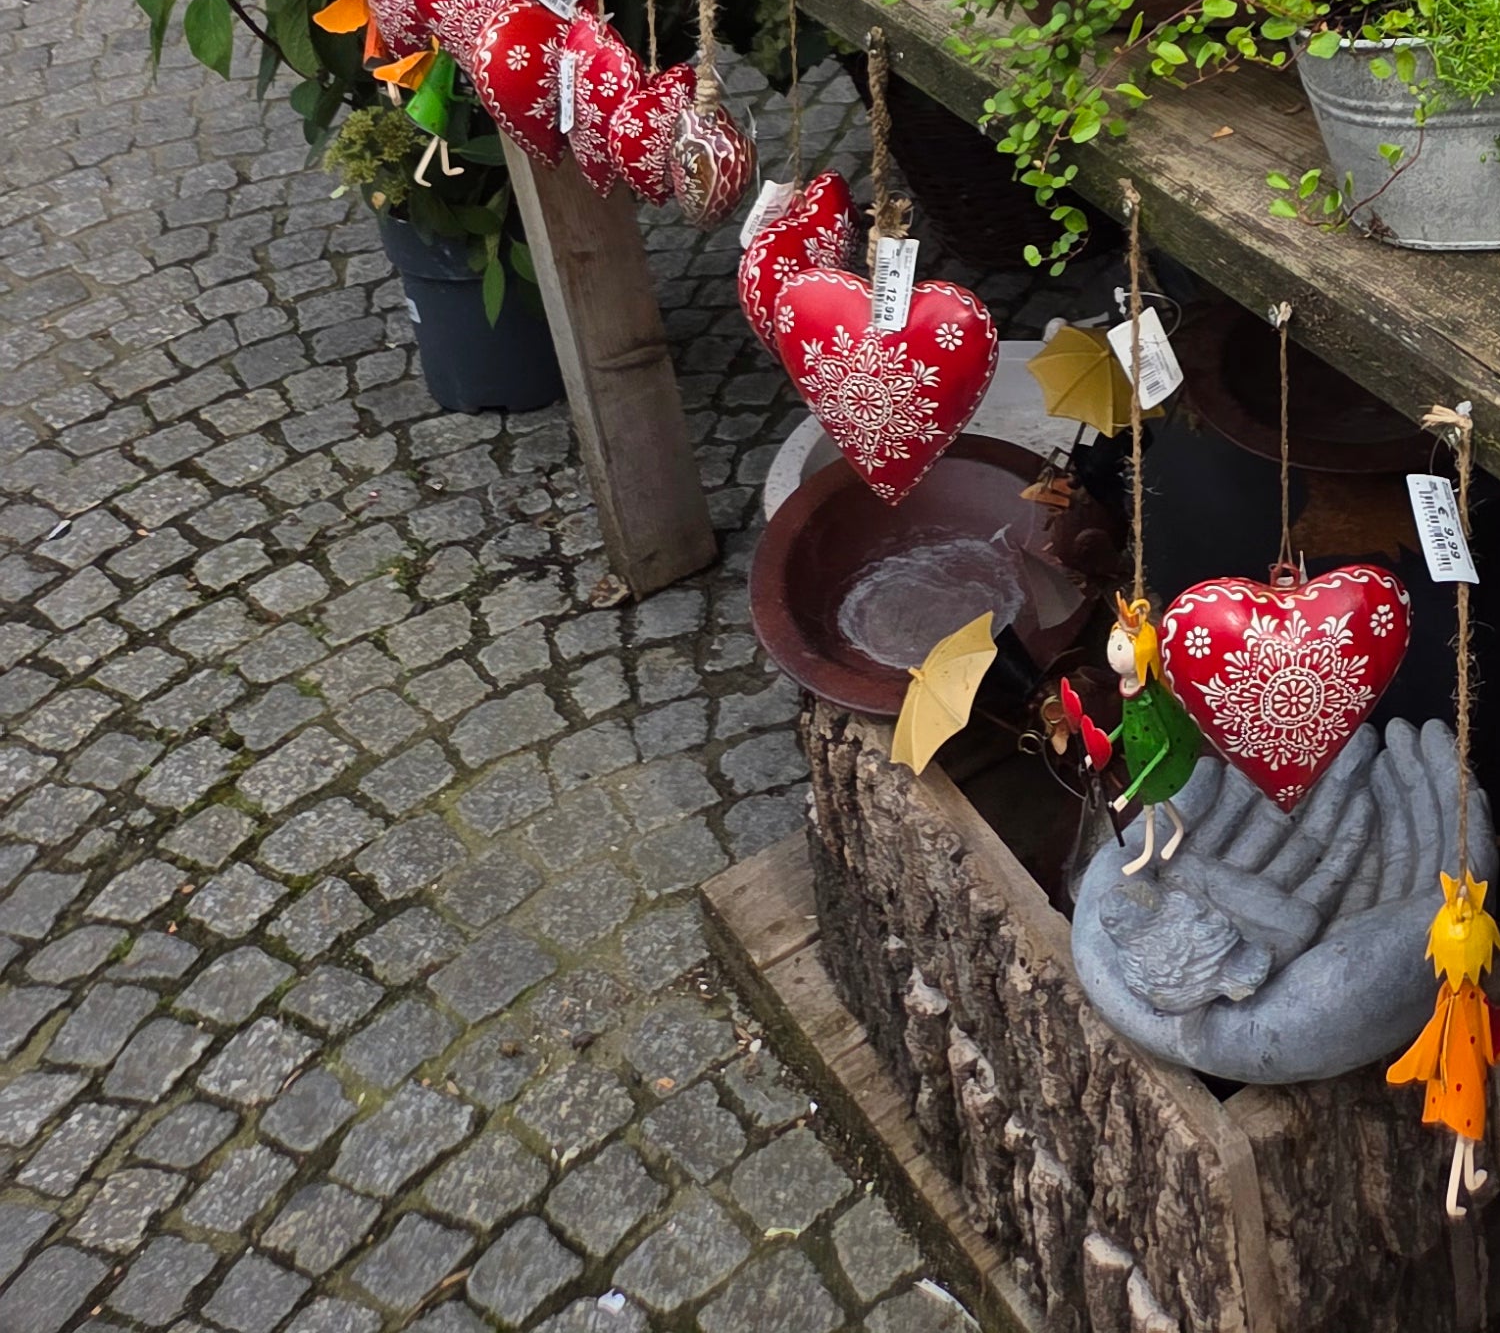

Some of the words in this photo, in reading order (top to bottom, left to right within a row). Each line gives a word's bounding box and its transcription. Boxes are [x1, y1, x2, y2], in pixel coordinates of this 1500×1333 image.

[889, 269, 900, 279] €
[883, 287, 898, 322] 12,99
[1438, 506, 1450, 519] €
[1443, 526, 1462, 561] 9,99
